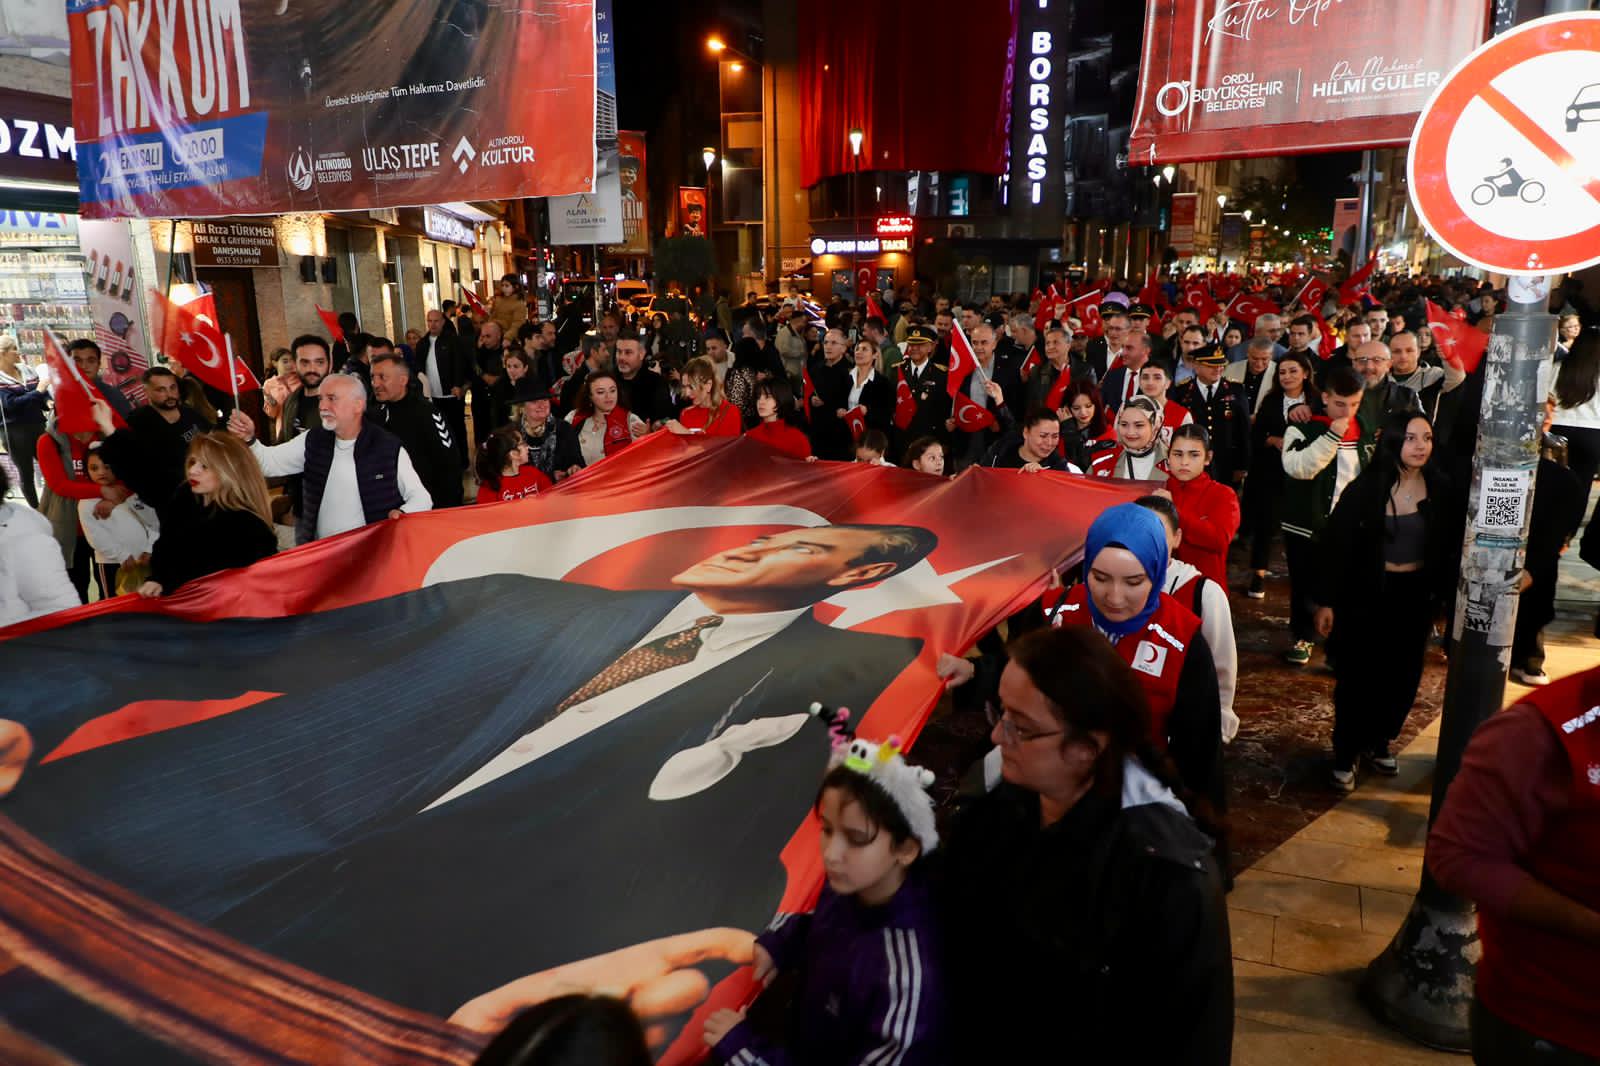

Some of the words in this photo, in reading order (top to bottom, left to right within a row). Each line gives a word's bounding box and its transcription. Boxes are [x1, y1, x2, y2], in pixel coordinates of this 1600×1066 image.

[1222, 72, 1255, 85] ORDU
[391, 86, 408, 97] Tüm
[409, 82, 445, 96] Halkımız
[446, 76, 487, 92] Davetlidir.
[1027, 31, 1052, 204] BORSASI
[488, 135, 525, 148] ALTINORDU
[481, 146, 535, 167] KÜLTÜR
[315, 157, 352, 172] ALTINORDU
[193, 223, 206, 234] Ali
[207, 224, 229, 235] Rıza
[230, 223, 275, 237] TÜRKMEN
[195, 235, 219, 244] EMLAK
[227, 236, 275, 247] GAYRİMENKUL
[212, 246, 261, 257] DANIŞMANLIĞI
